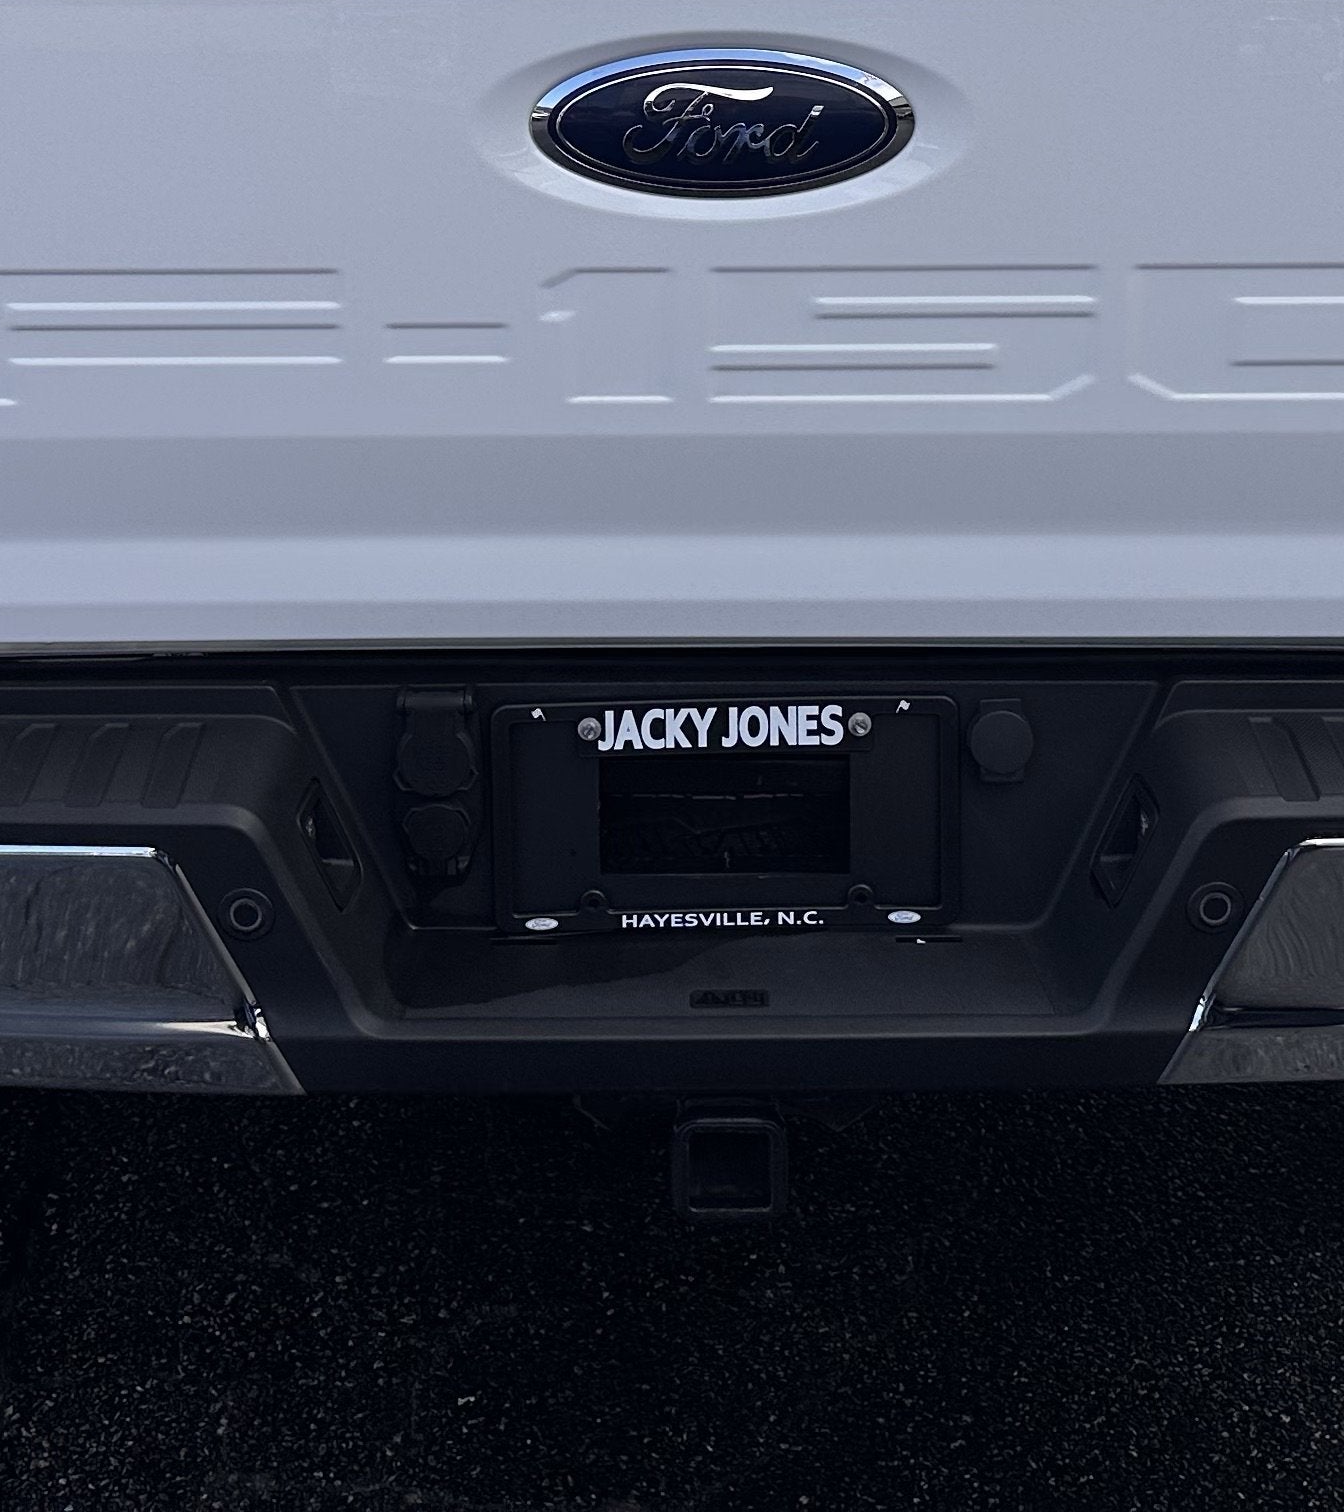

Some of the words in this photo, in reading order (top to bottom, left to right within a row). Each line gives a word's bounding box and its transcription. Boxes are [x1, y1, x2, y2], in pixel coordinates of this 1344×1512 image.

[622, 82, 822, 166] Ford
[598, 707, 717, 752] JACKY
[721, 704, 844, 747] JONES
[621, 912, 770, 929] HAYESVILLE,
[777, 910, 824, 925] N.C.
